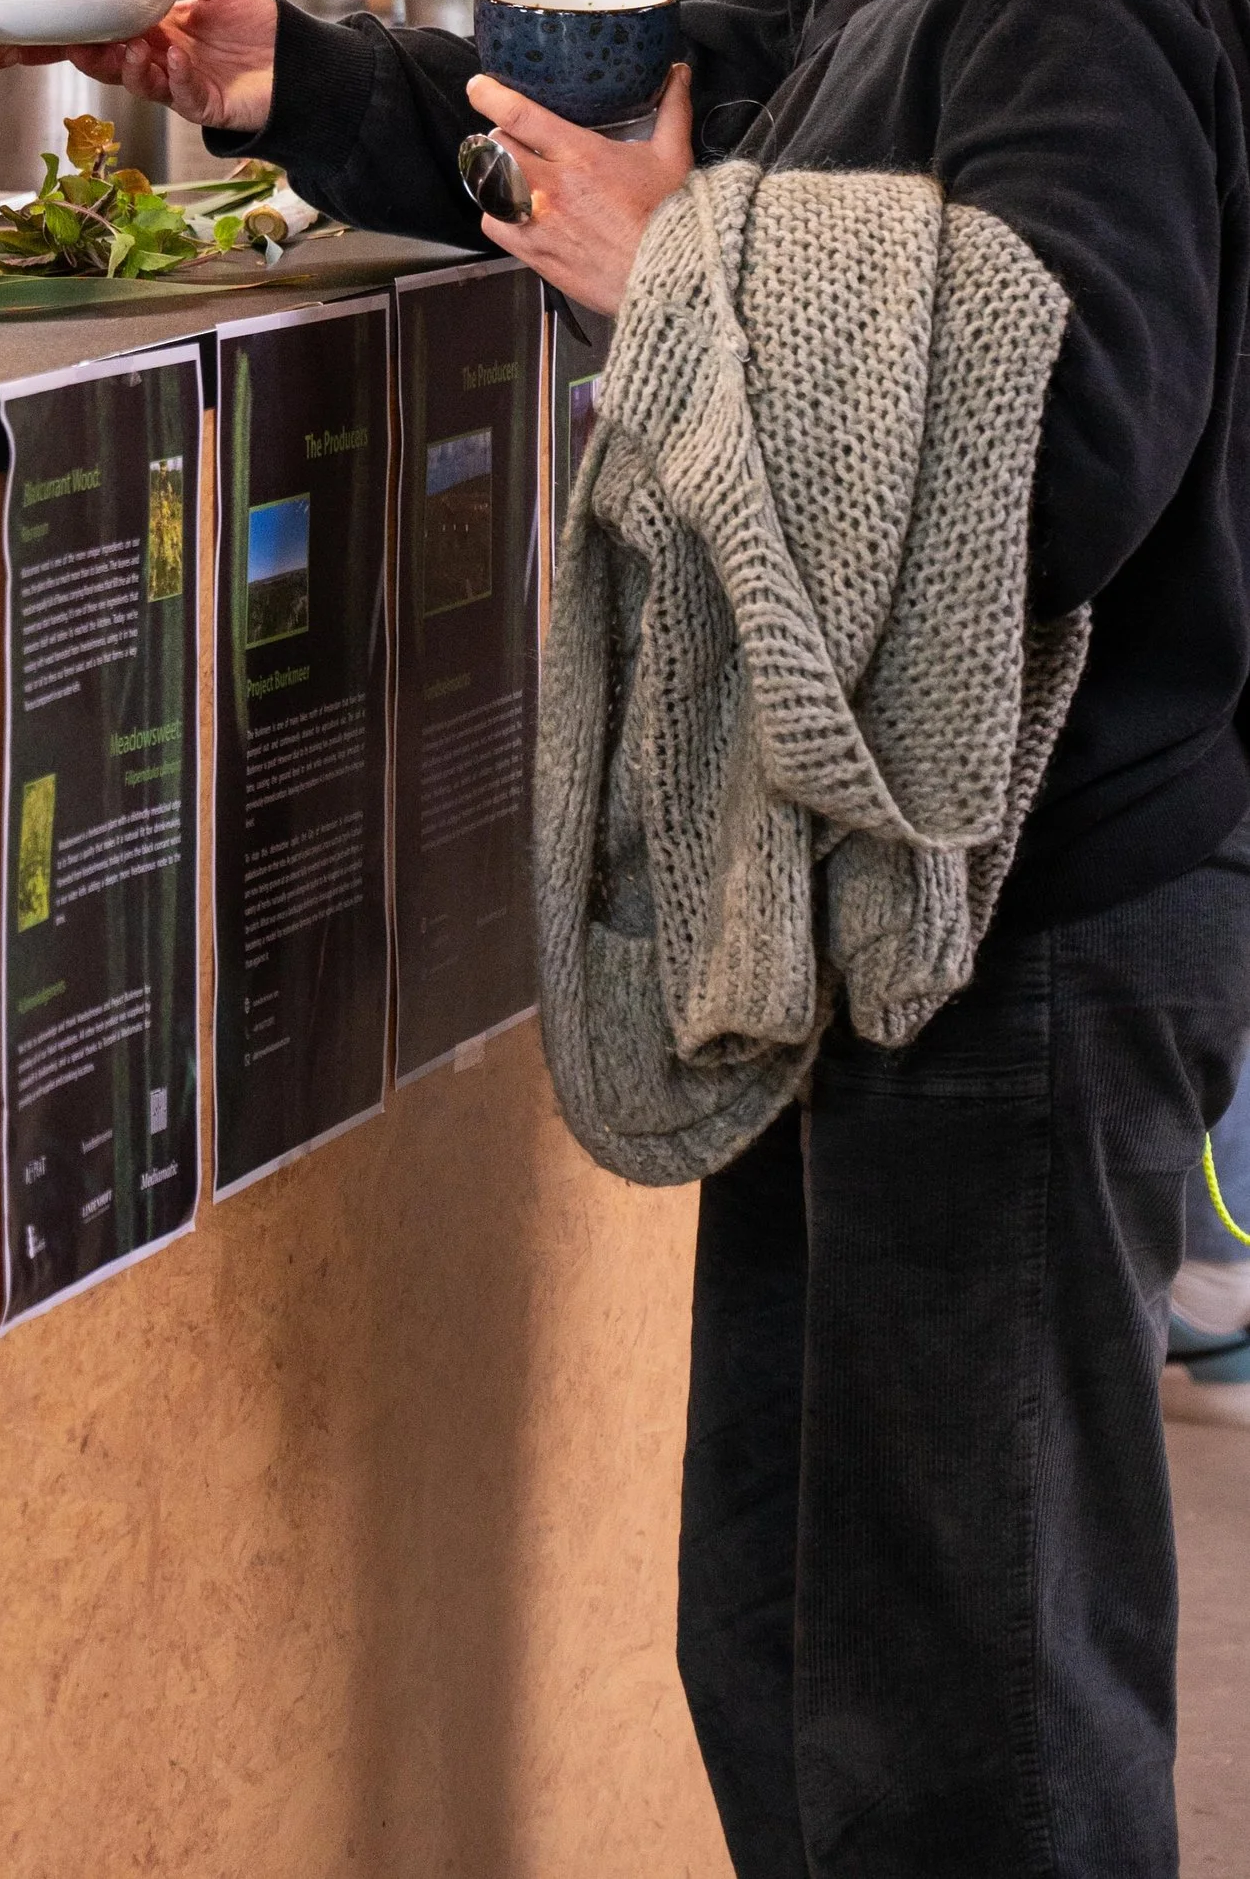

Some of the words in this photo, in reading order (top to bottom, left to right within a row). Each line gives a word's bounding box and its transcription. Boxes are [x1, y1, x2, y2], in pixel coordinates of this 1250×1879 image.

[462, 365, 477, 392] The
[478, 360, 519, 387] Producers
[305, 432, 322, 459] The
[324, 425, 368, 455] Producers
[246, 674, 274, 700] Project
